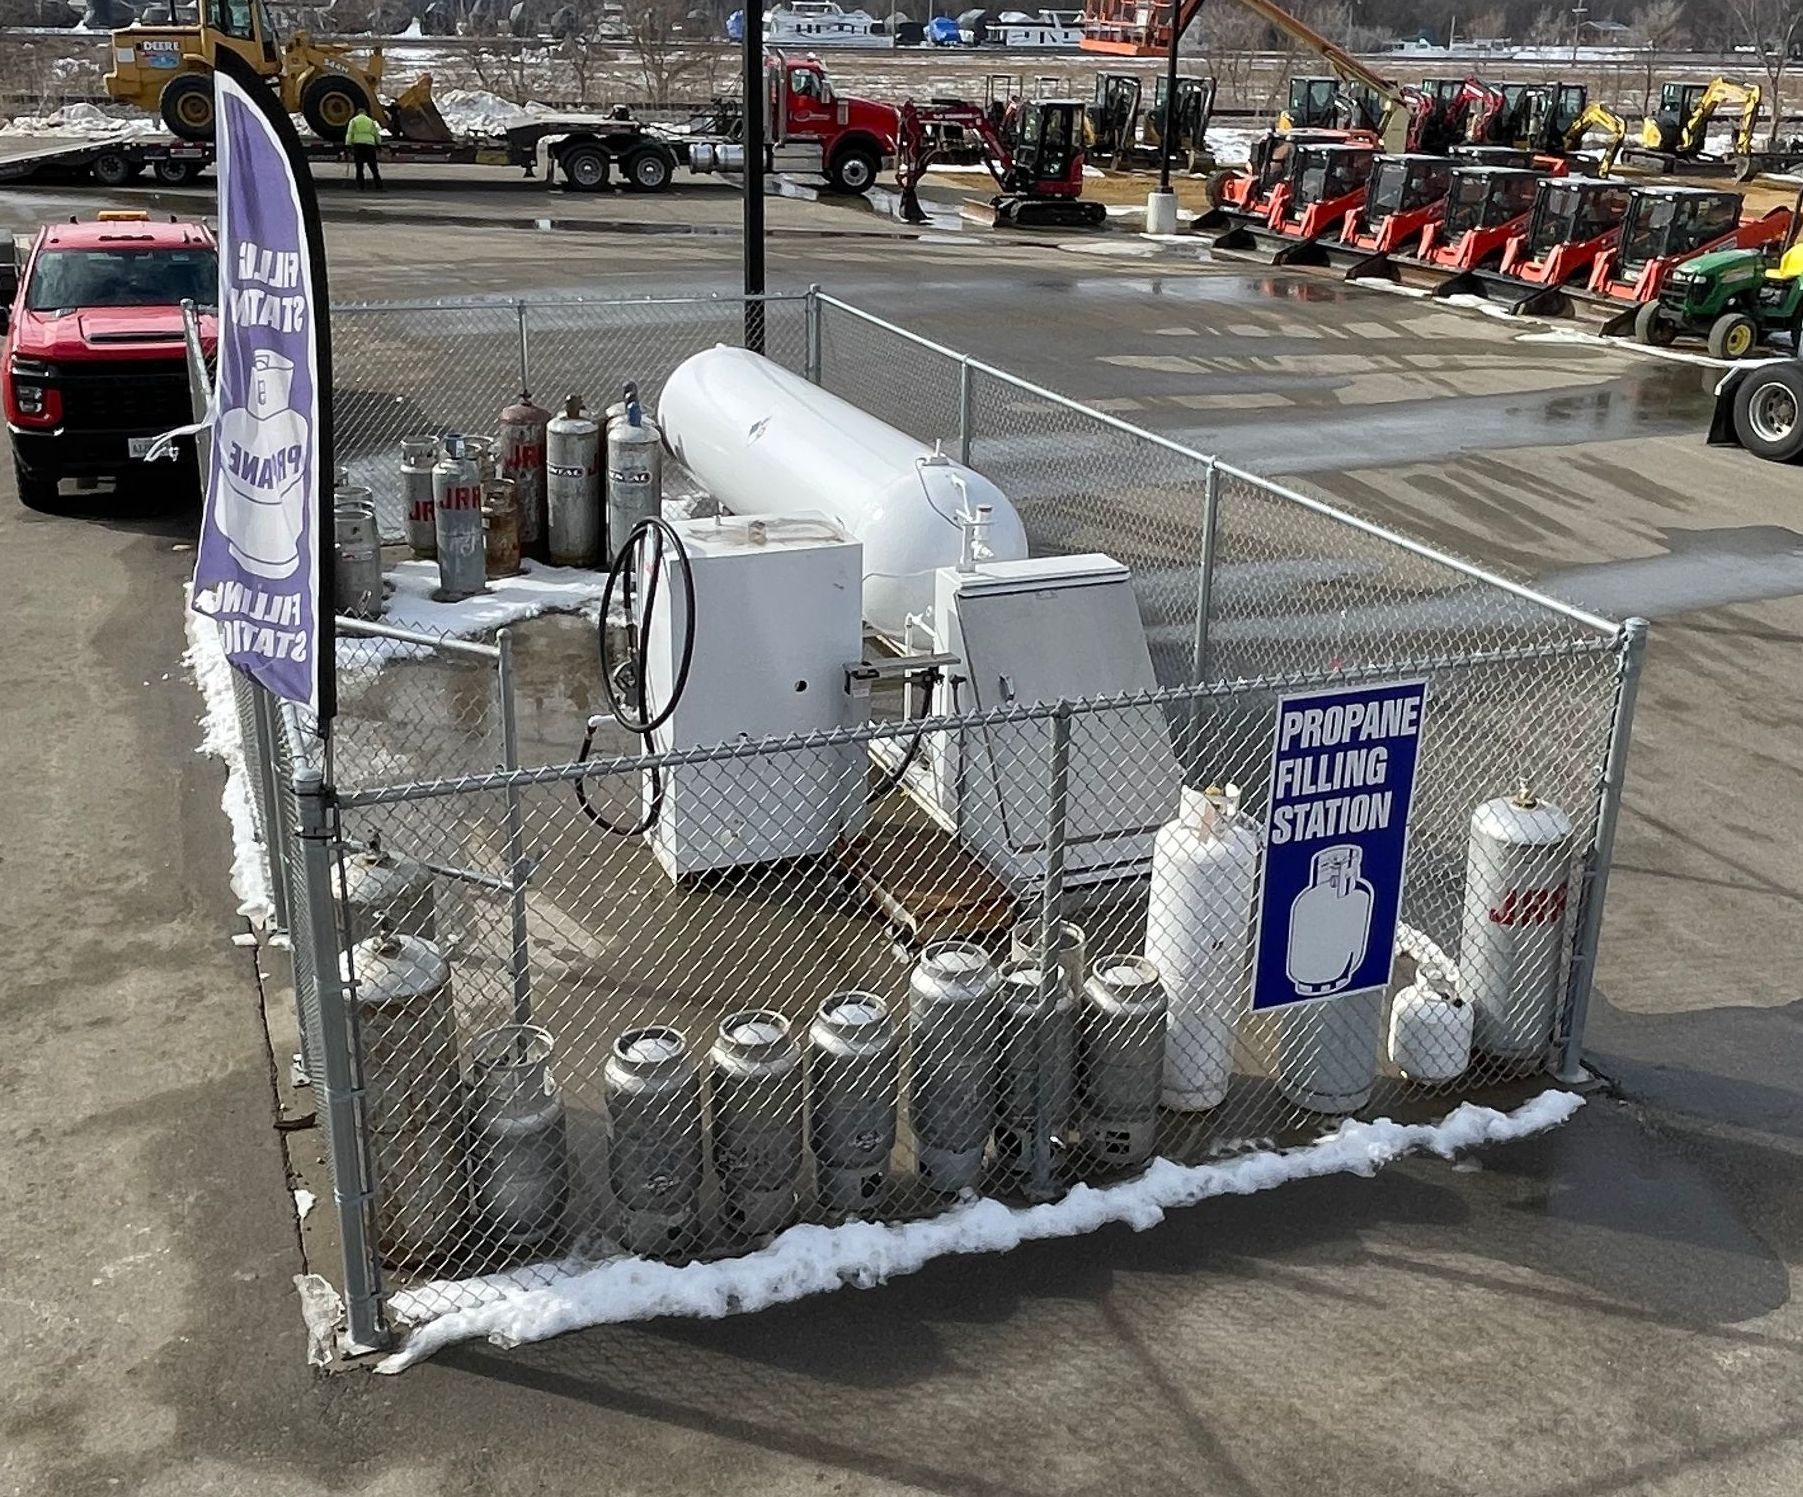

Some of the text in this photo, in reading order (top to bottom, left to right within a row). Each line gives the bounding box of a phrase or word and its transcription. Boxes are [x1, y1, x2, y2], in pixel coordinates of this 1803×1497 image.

[143, 40, 179, 51] DEERE
[1280, 696, 1420, 752] PROPANE
[1276, 746, 1388, 799] FILLING
[1271, 790, 1393, 845] STATION
